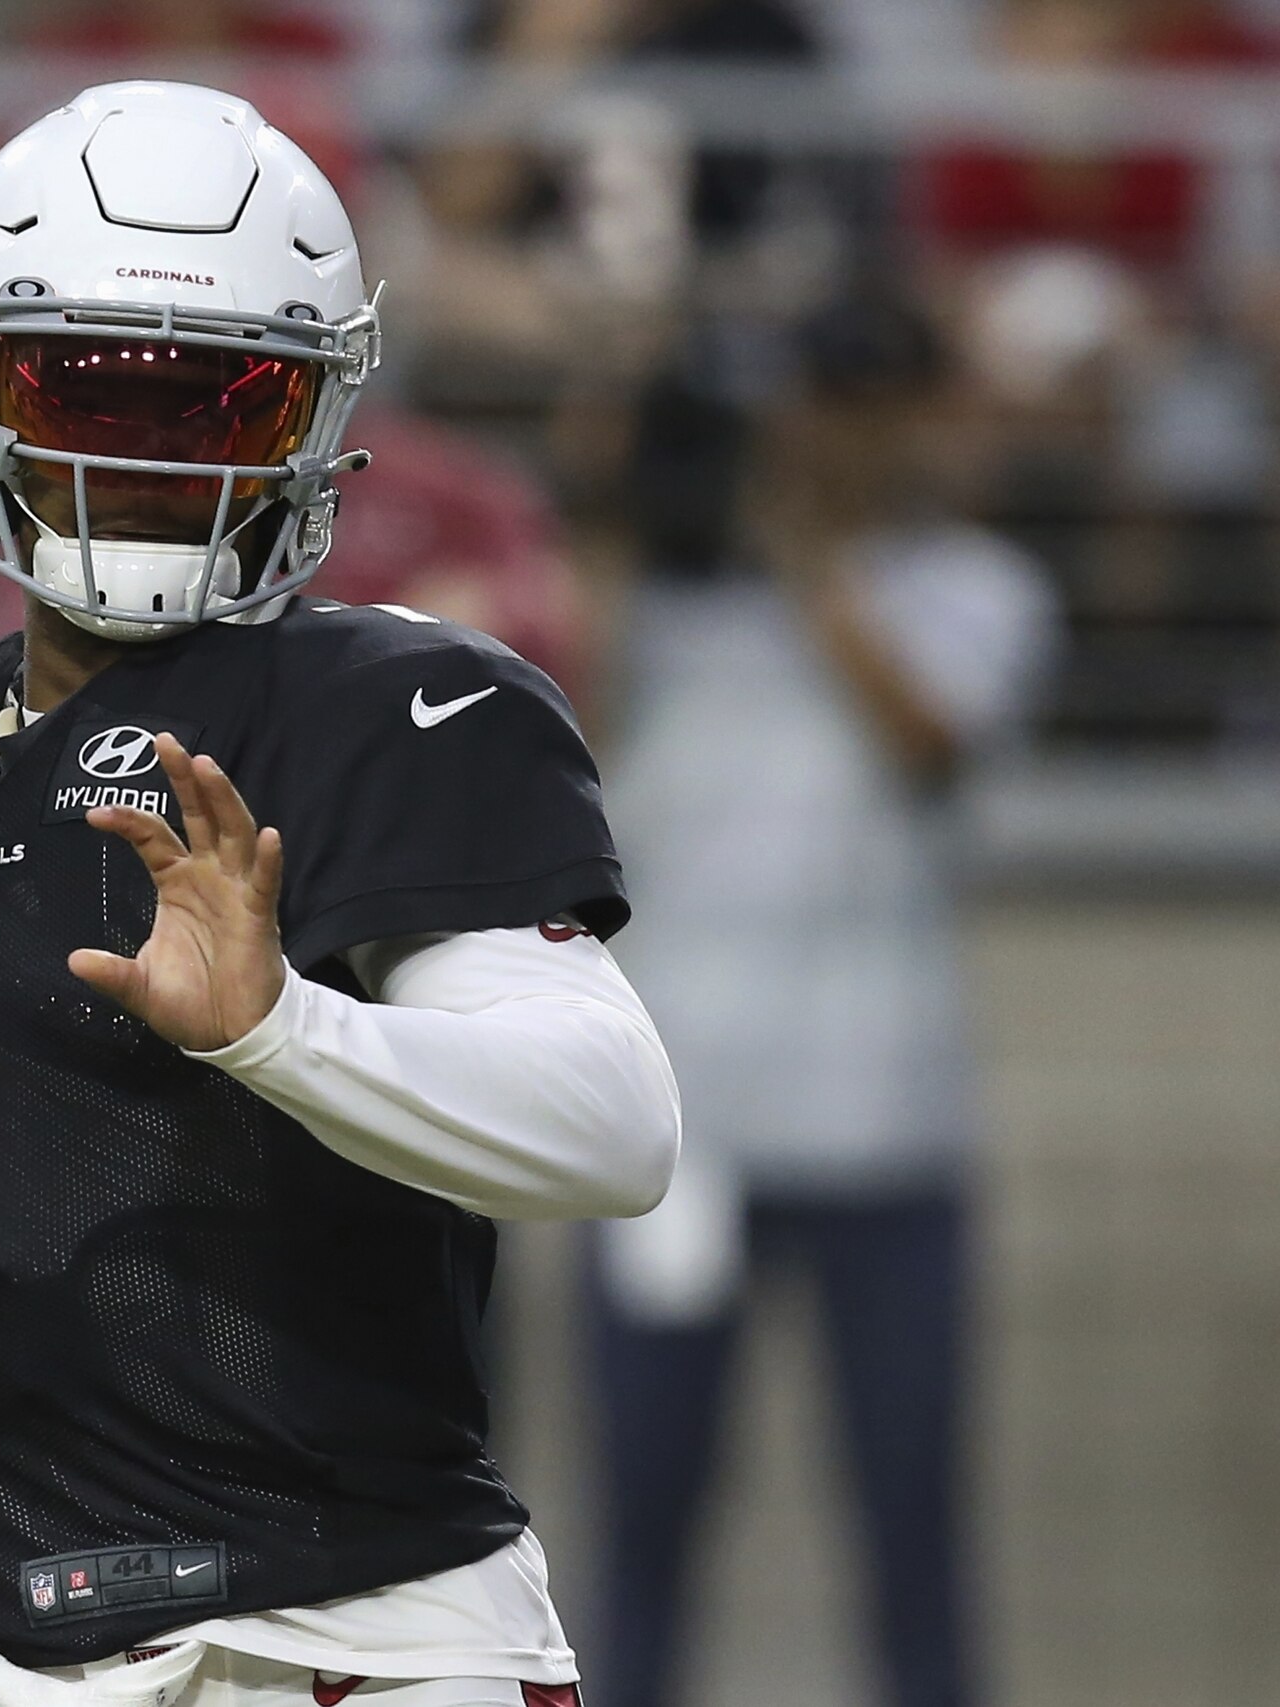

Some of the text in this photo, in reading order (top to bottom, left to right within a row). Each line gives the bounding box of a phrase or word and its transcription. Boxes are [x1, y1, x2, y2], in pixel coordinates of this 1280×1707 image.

[115, 267, 216, 286] CARDINALS
[54, 785, 168, 816] HYUNDAI
[112, 1552, 155, 1578] 44
